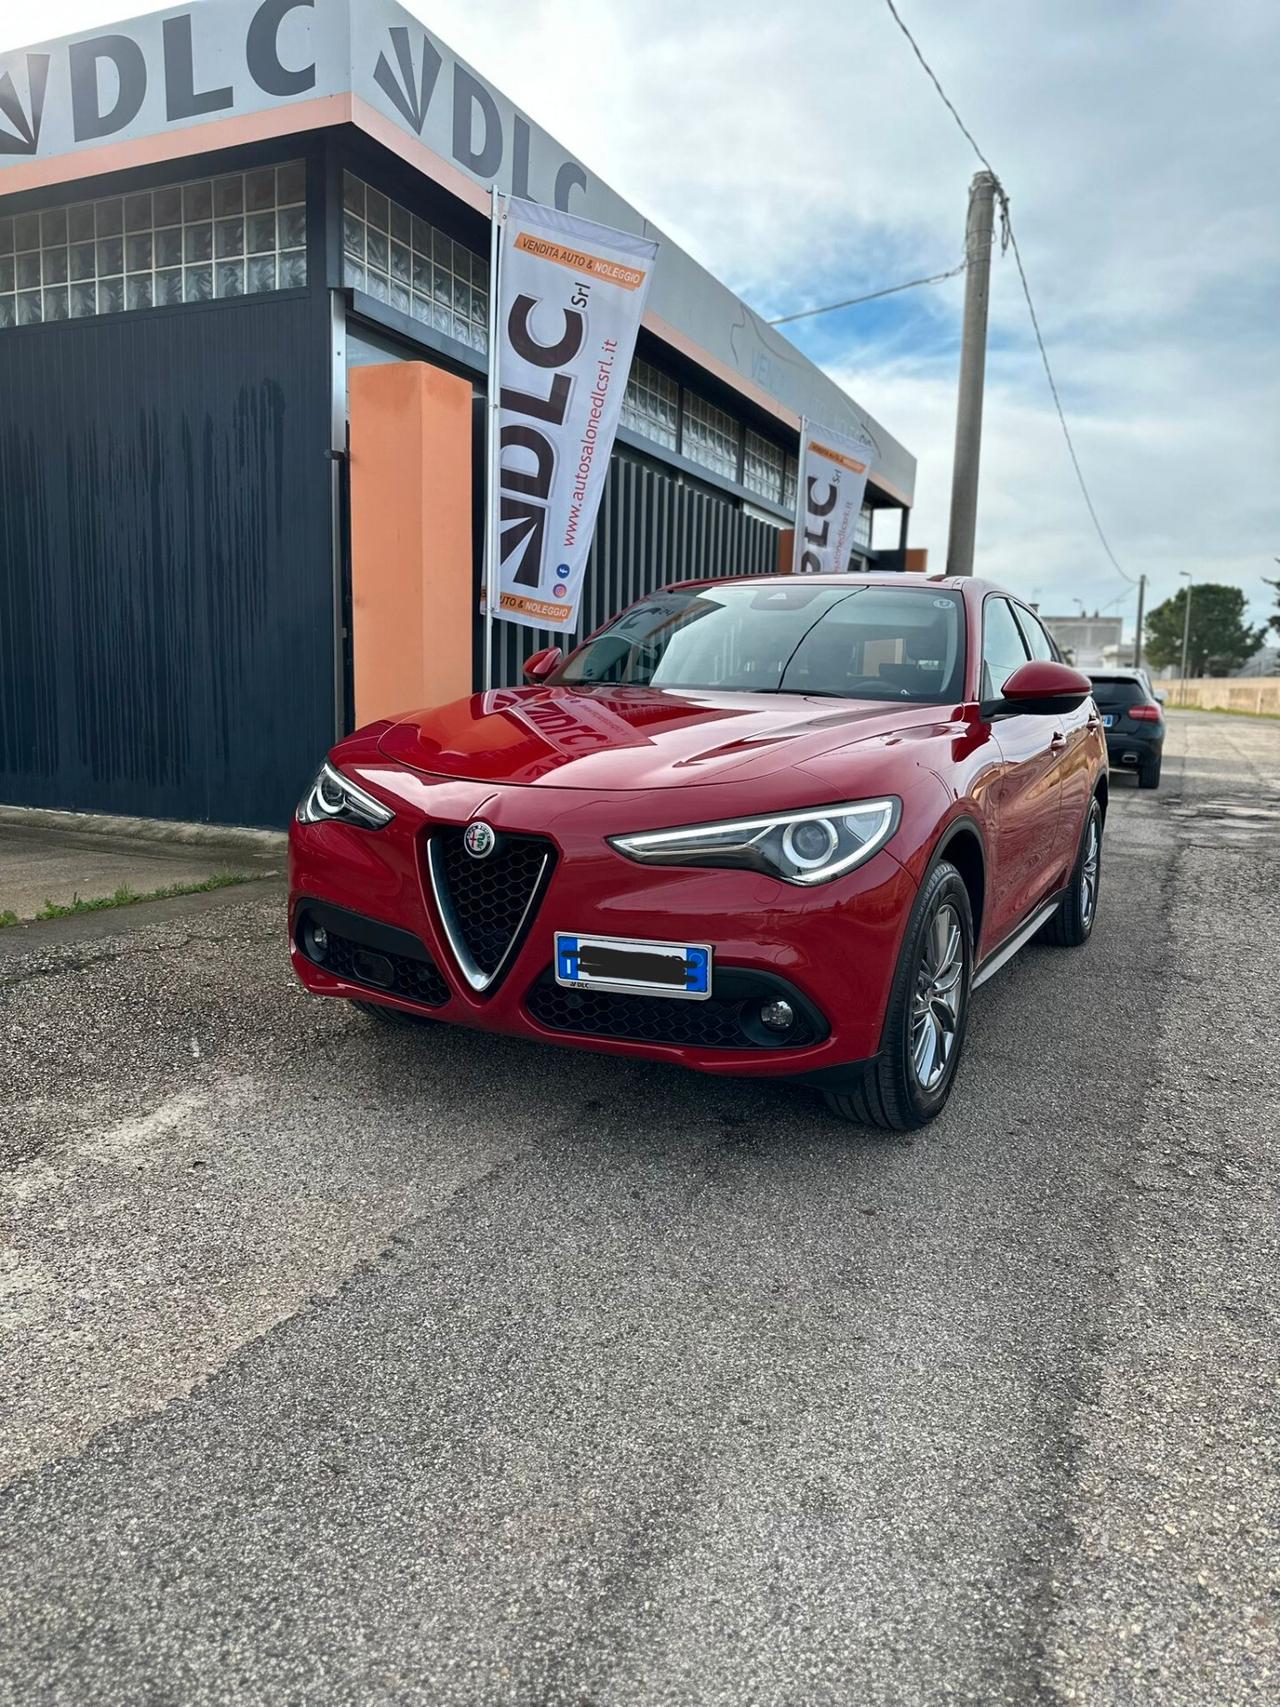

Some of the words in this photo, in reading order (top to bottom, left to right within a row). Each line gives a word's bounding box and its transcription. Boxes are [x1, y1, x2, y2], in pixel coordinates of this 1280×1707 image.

[69, 0, 317, 143] DLC
[522, 237, 559, 259] VENDITA
[560, 251, 585, 267] AUTO
[586, 259, 593, 269] &
[594, 262, 640, 284] NOLEGGIO
[500, 294, 584, 500] DLC
[571, 282, 591, 308] Srl
[563, 338, 617, 547] www.autosalonedlcsrl.it
[500, 595, 516, 607] UTO
[517, 600, 524, 609] &
[525, 601, 568, 617] NOLEGGIO
